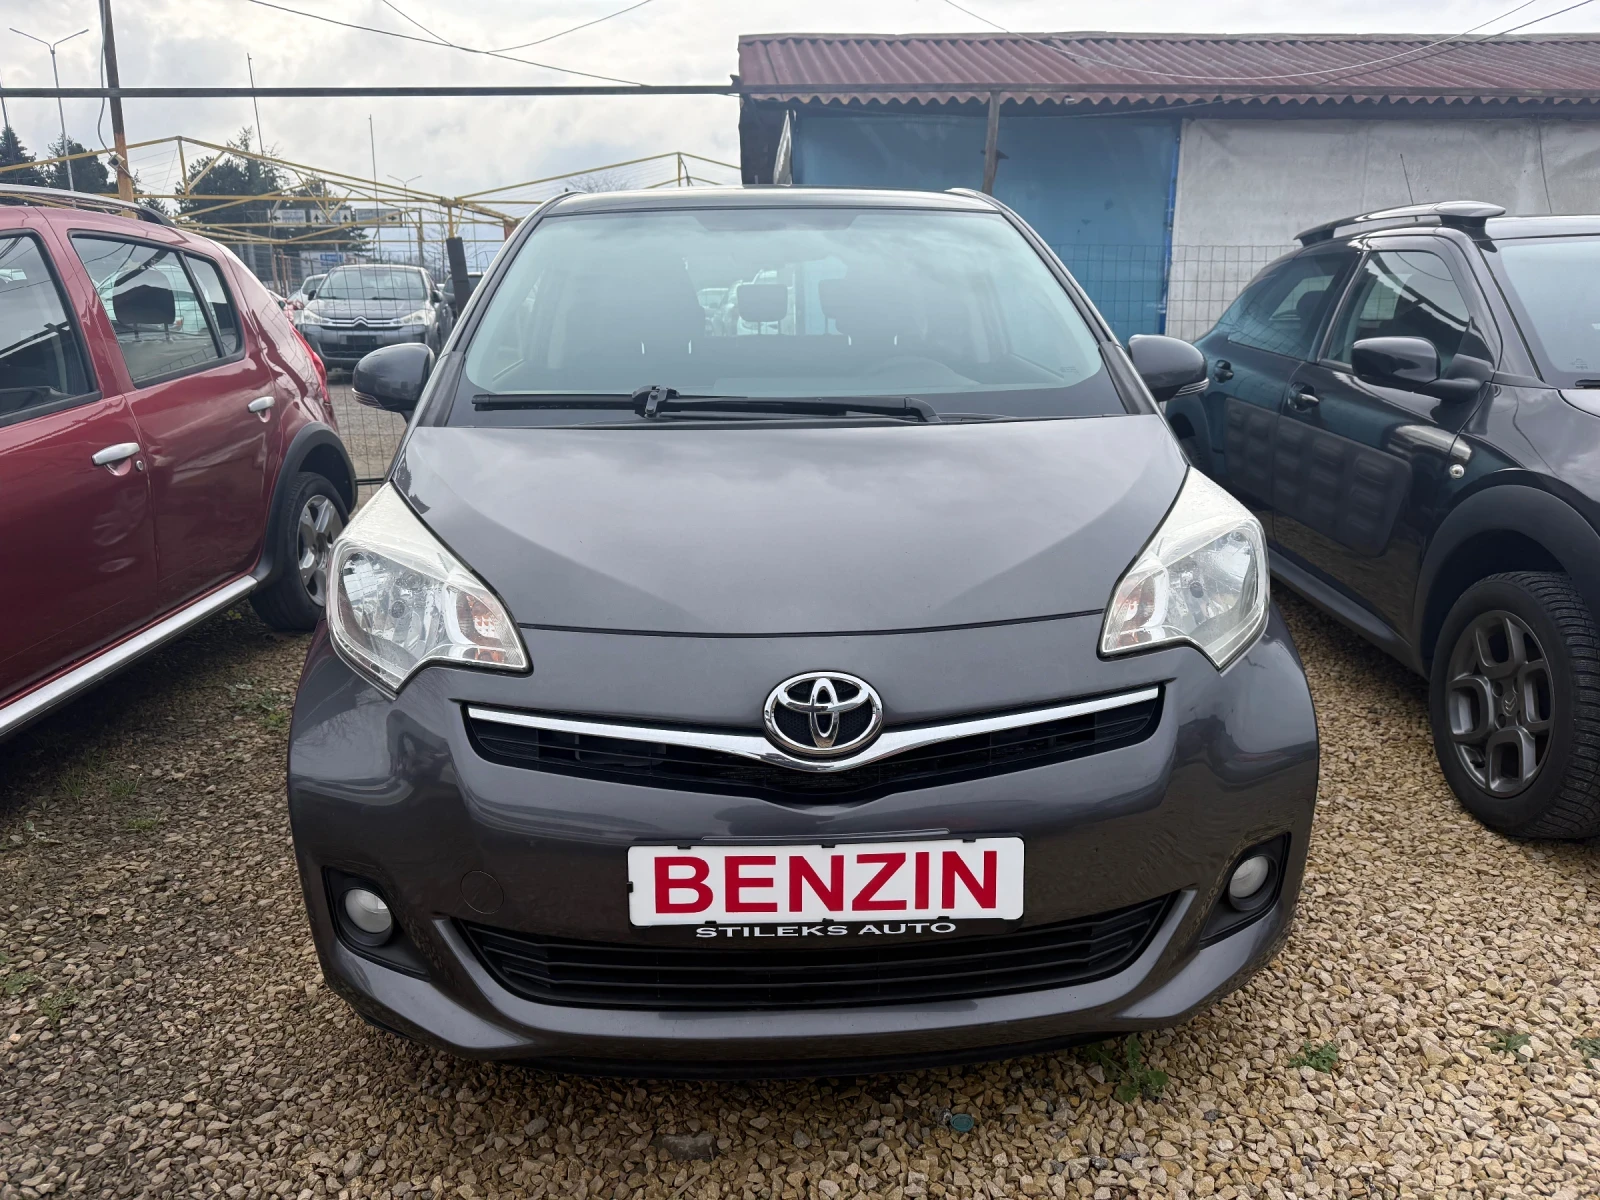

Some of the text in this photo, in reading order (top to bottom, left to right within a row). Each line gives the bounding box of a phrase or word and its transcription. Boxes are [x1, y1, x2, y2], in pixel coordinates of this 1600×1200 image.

[654, 850, 997, 914] BENZIN
[695, 922, 957, 938] STILEKS AUTO
